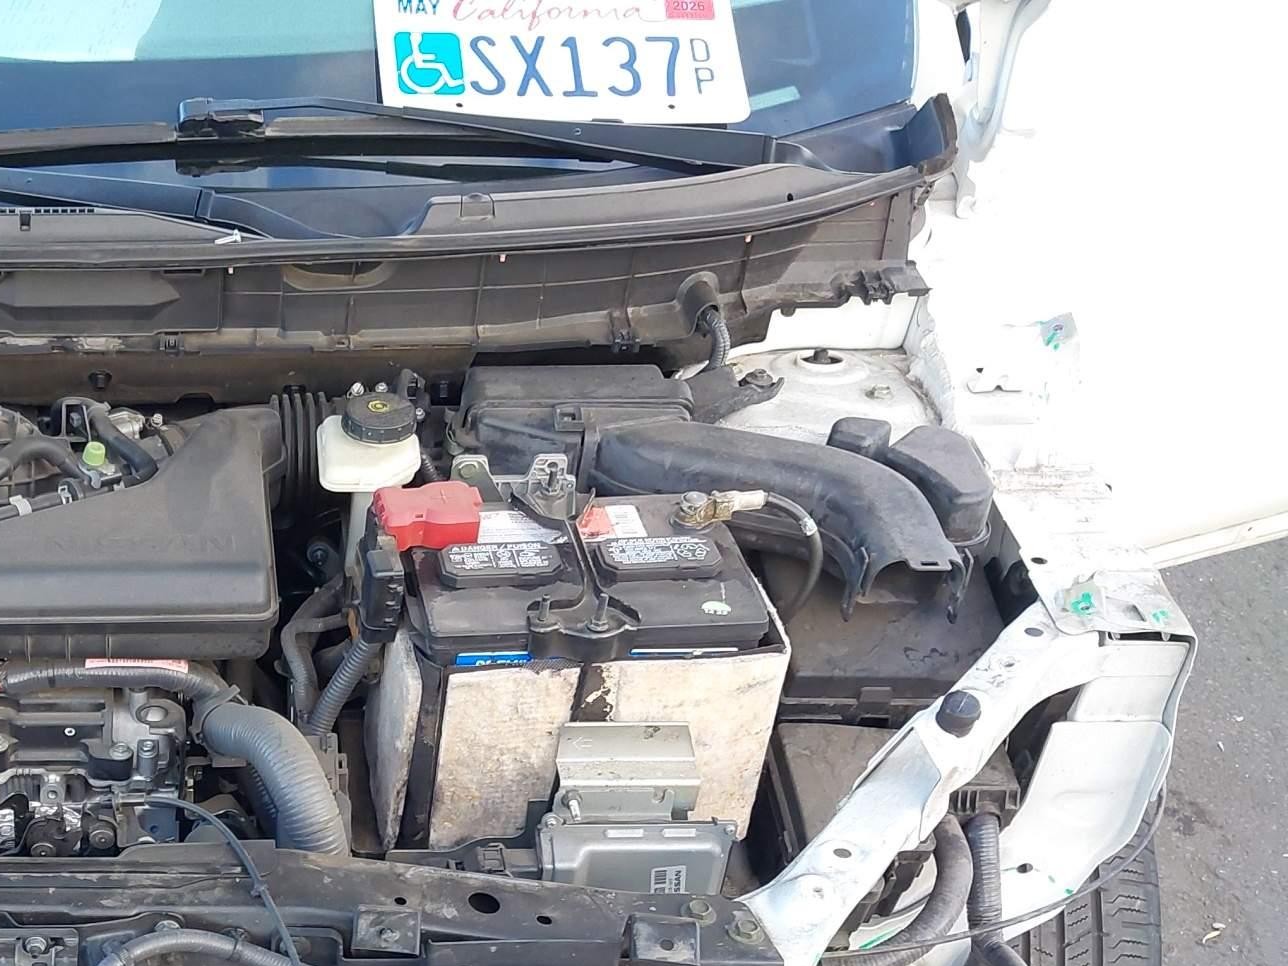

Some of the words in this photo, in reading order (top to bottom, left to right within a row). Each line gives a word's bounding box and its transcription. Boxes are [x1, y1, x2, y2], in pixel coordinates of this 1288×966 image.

[397, 0, 440, 15] MAY
[452, 0, 667, 31] California
[672, 0, 705, 12] 2026
[469, 35, 681, 98] SX137
